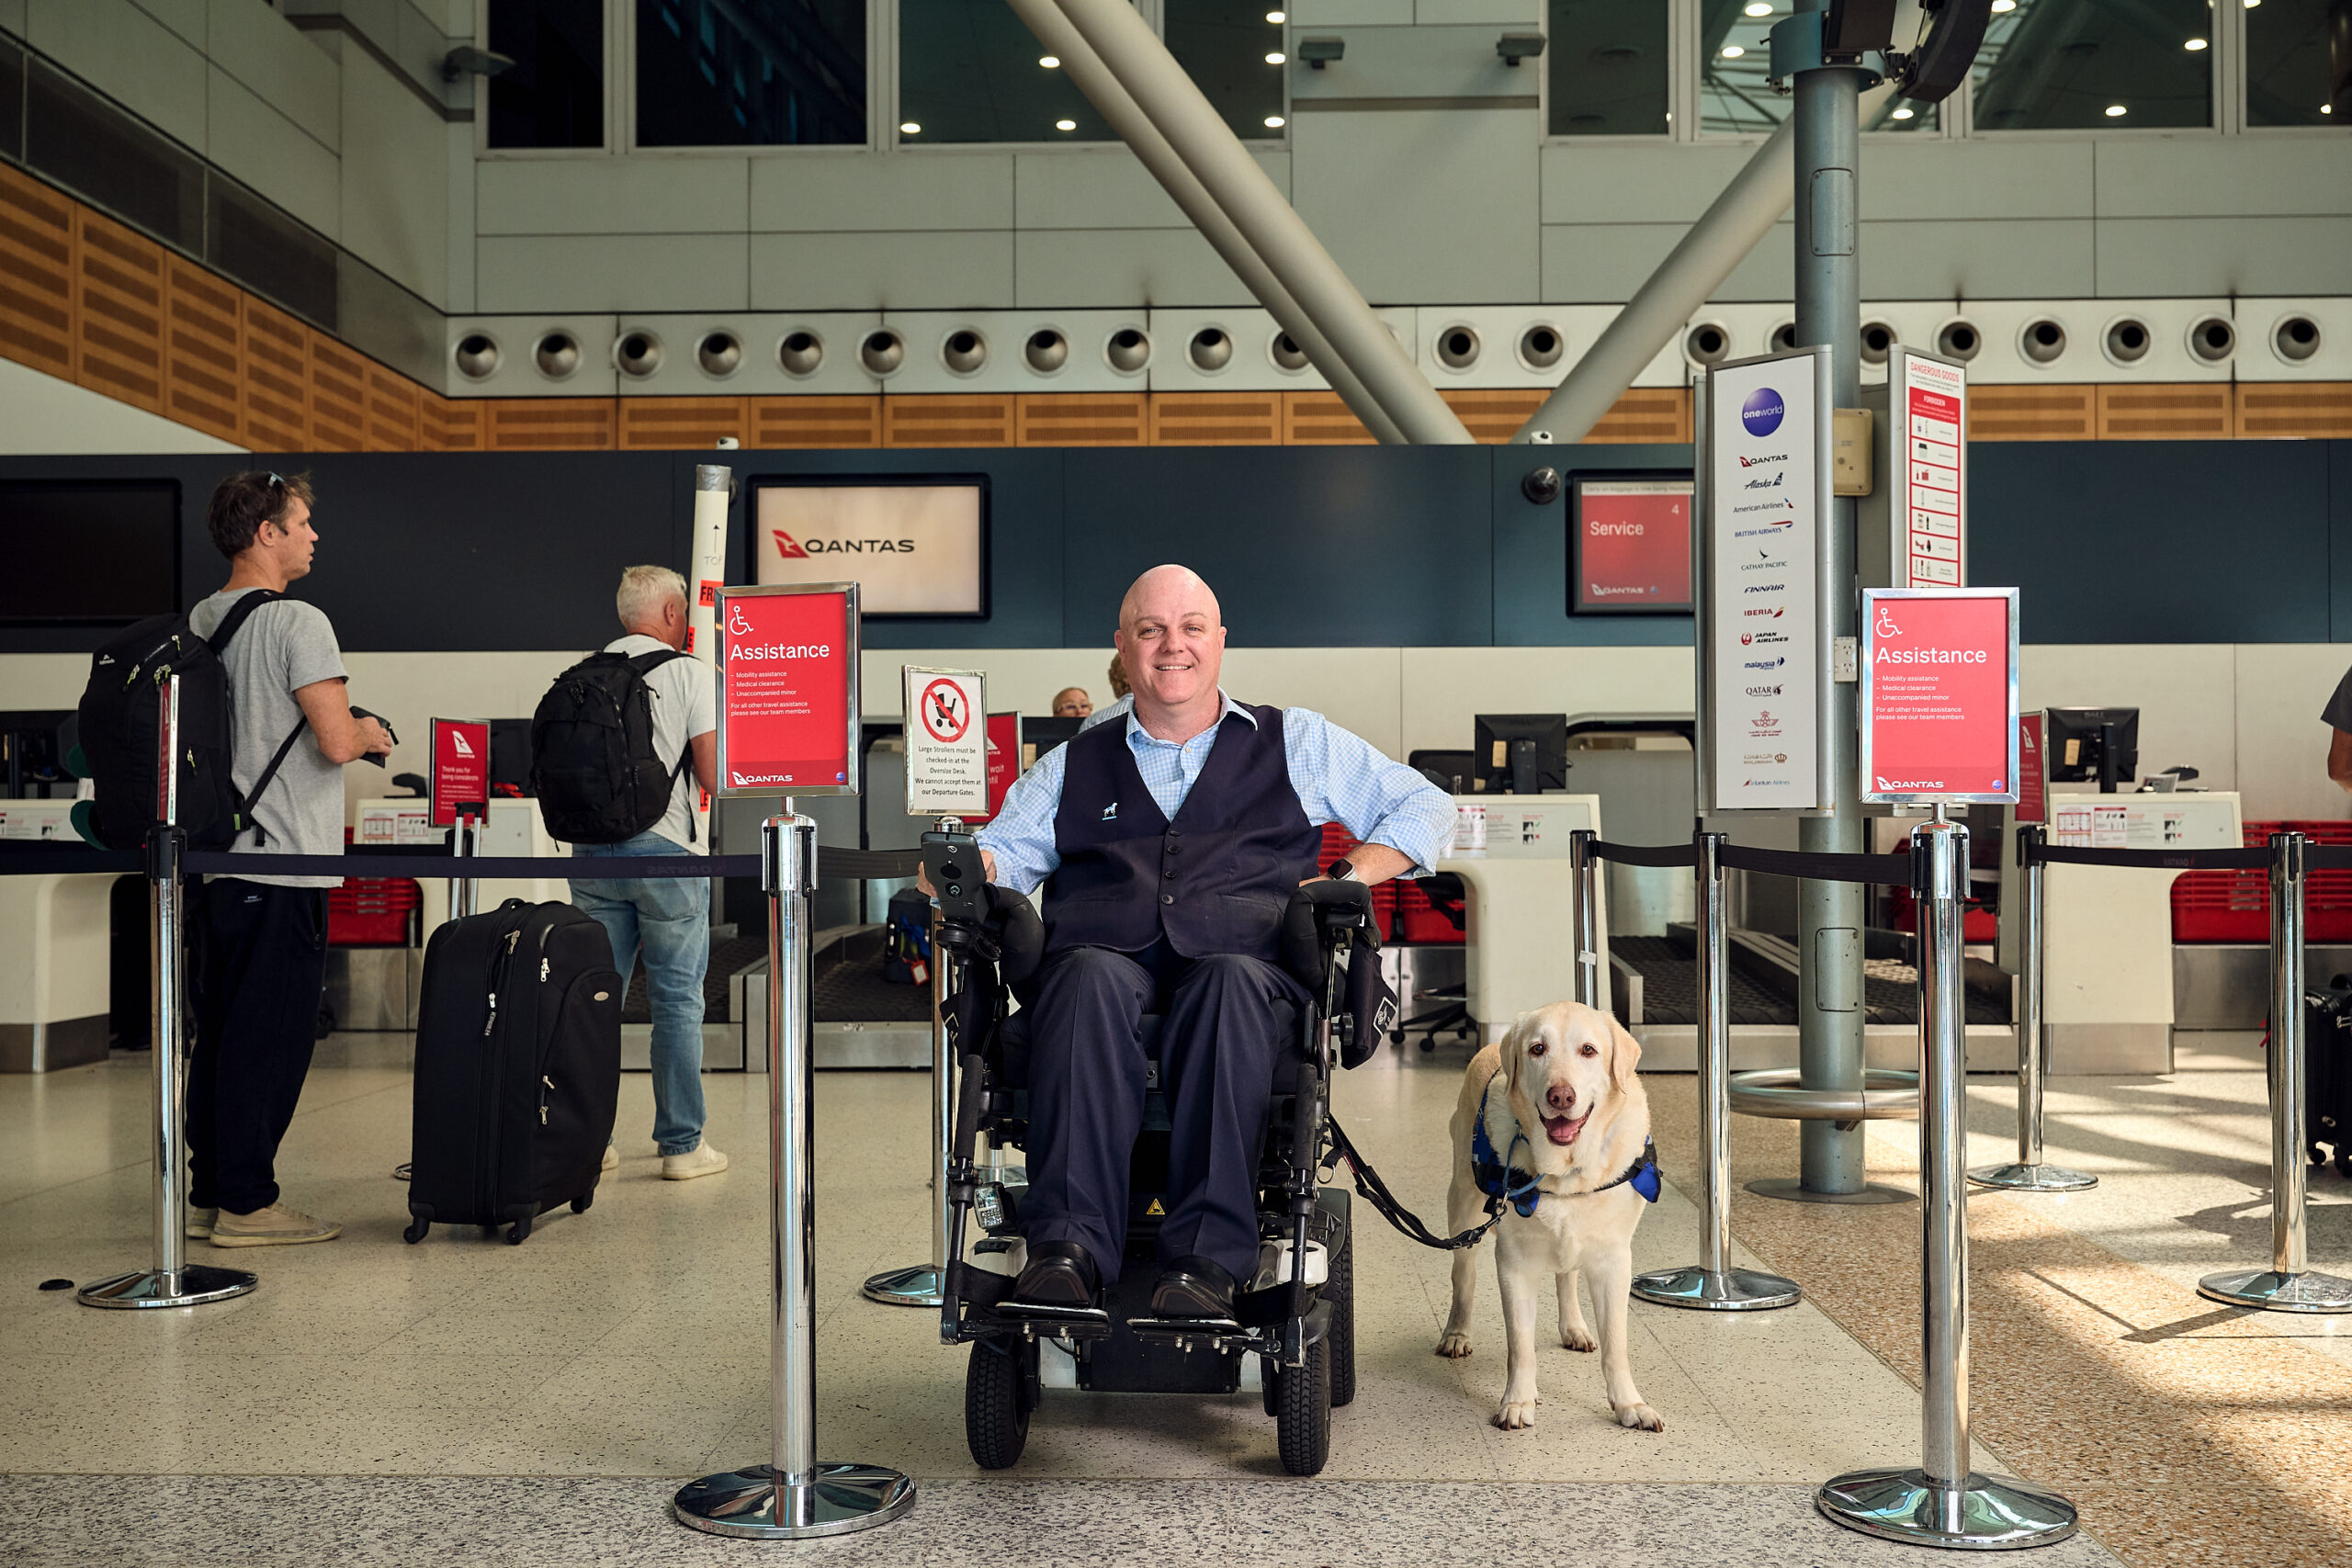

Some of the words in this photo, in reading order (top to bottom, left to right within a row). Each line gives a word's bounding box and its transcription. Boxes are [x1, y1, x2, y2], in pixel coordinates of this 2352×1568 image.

[1911, 362, 1940, 378] DANGEROUS
[1942, 369, 1959, 382] GOODS
[1744, 404, 1782, 419] oneworld
[1750, 455, 1788, 464] QANTAS
[1744, 479, 1771, 490] Alaska
[1671, 504, 1679, 514] 4
[1589, 521, 1644, 536] Service
[1735, 529, 1757, 537] BRITISH
[805, 540, 915, 553] QANTAS
[1741, 562, 1764, 570] CATHAY
[1745, 584, 1784, 593] FINNAIR
[700, 586, 715, 602] FR
[1744, 608, 1773, 616] IBERIA
[729, 643, 830, 660] Assistance
[1876, 647, 1986, 663] Assistance
[1746, 686, 1771, 695] QATAR
[989, 764, 1004, 773] wait
[746, 774, 793, 783] QANTAS
[989, 775, 998, 784] ntil
